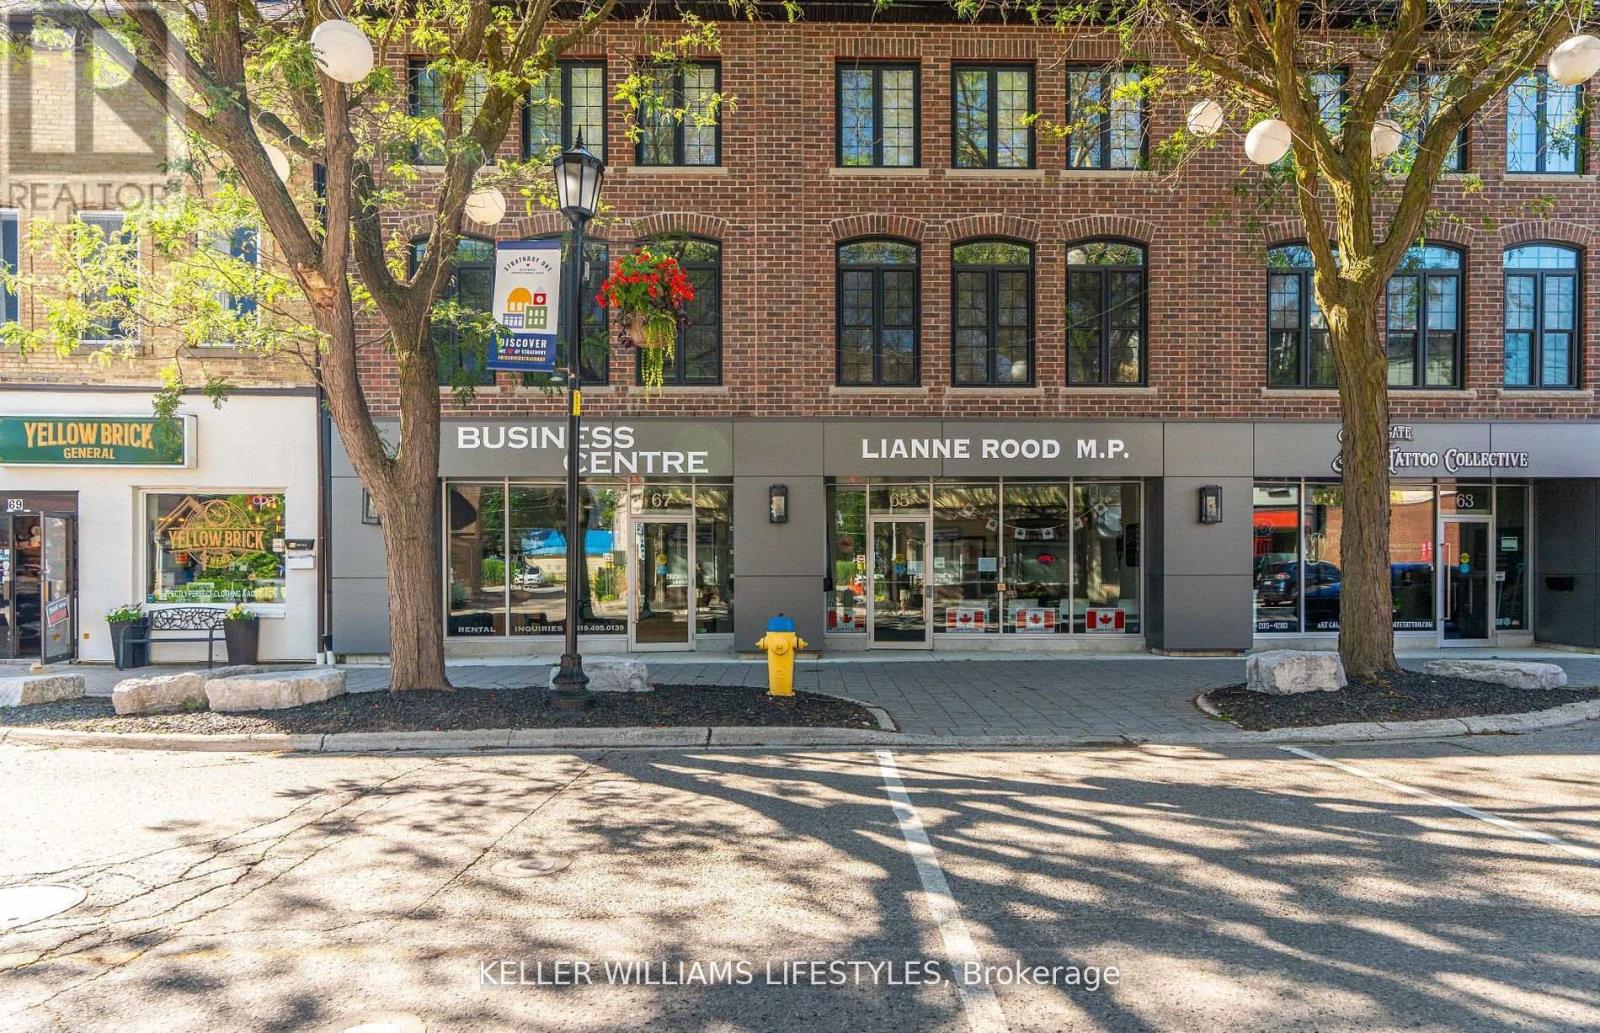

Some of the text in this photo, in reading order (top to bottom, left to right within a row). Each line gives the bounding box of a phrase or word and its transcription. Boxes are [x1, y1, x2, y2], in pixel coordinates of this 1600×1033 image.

[499, 338, 547, 348] DISCOVER
[24, 422, 155, 449] YELLOW BRICK
[457, 426, 635, 449] BUSINESS
[63, 447, 116, 459] GENERAL
[861, 438, 1130, 459] LIANNE ROOD M.P.
[563, 451, 709, 474] CENTRE
[8, 500, 23, 510] 69
[651, 493, 673, 507] 67
[889, 493, 910, 507] 65
[1456, 493, 1474, 508] 63
[168, 529, 266, 550] YELLOW BRICK
